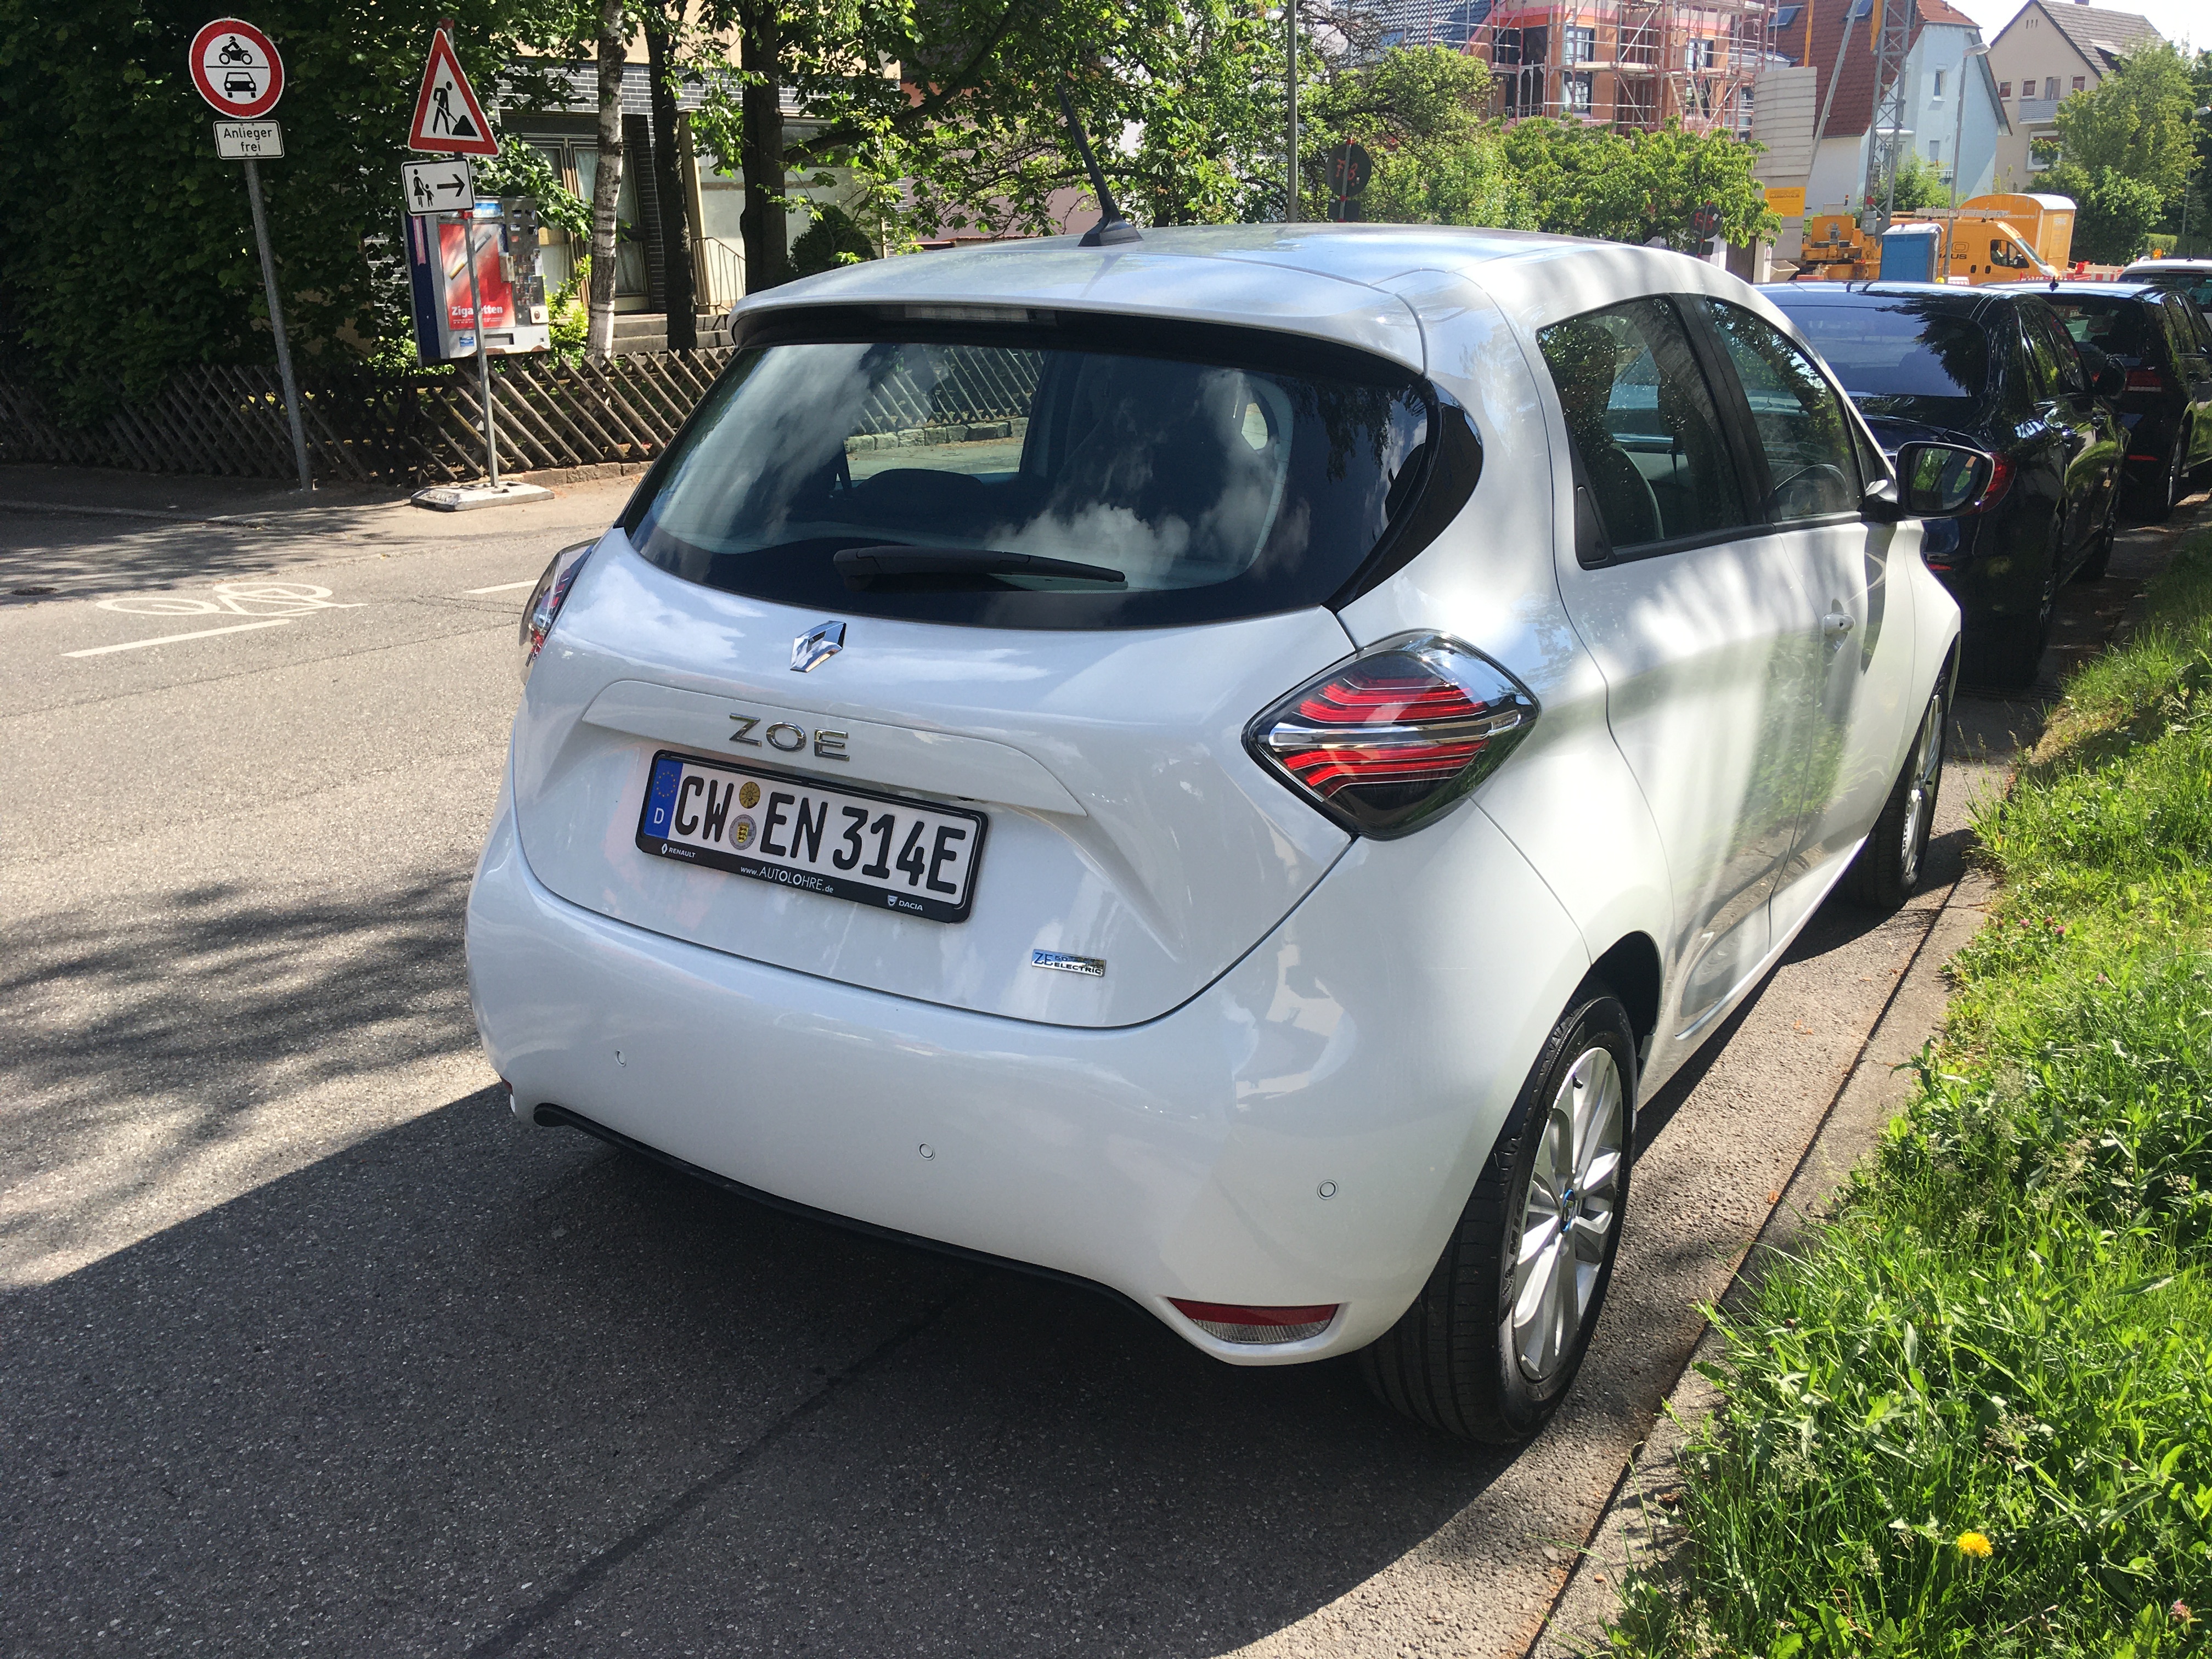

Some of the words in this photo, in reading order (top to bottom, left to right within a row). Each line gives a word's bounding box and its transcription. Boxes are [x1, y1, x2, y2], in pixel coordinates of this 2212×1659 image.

[224, 127, 272, 140] Anlieger
[240, 141, 261, 152] frei
[451, 305, 503, 318] Zigatten
[729, 712, 850, 761] ZOE
[654, 807, 665, 824] D
[675, 775, 735, 842] CW
[759, 791, 829, 864] EN
[832, 805, 967, 895] 314E
[668, 847, 696, 859] RENAULT
[741, 866, 834, 894] www.AUTOLOHRE.de
[898, 900, 923, 912] DACIA
[1054, 962, 1102, 975] ELECTRIC
